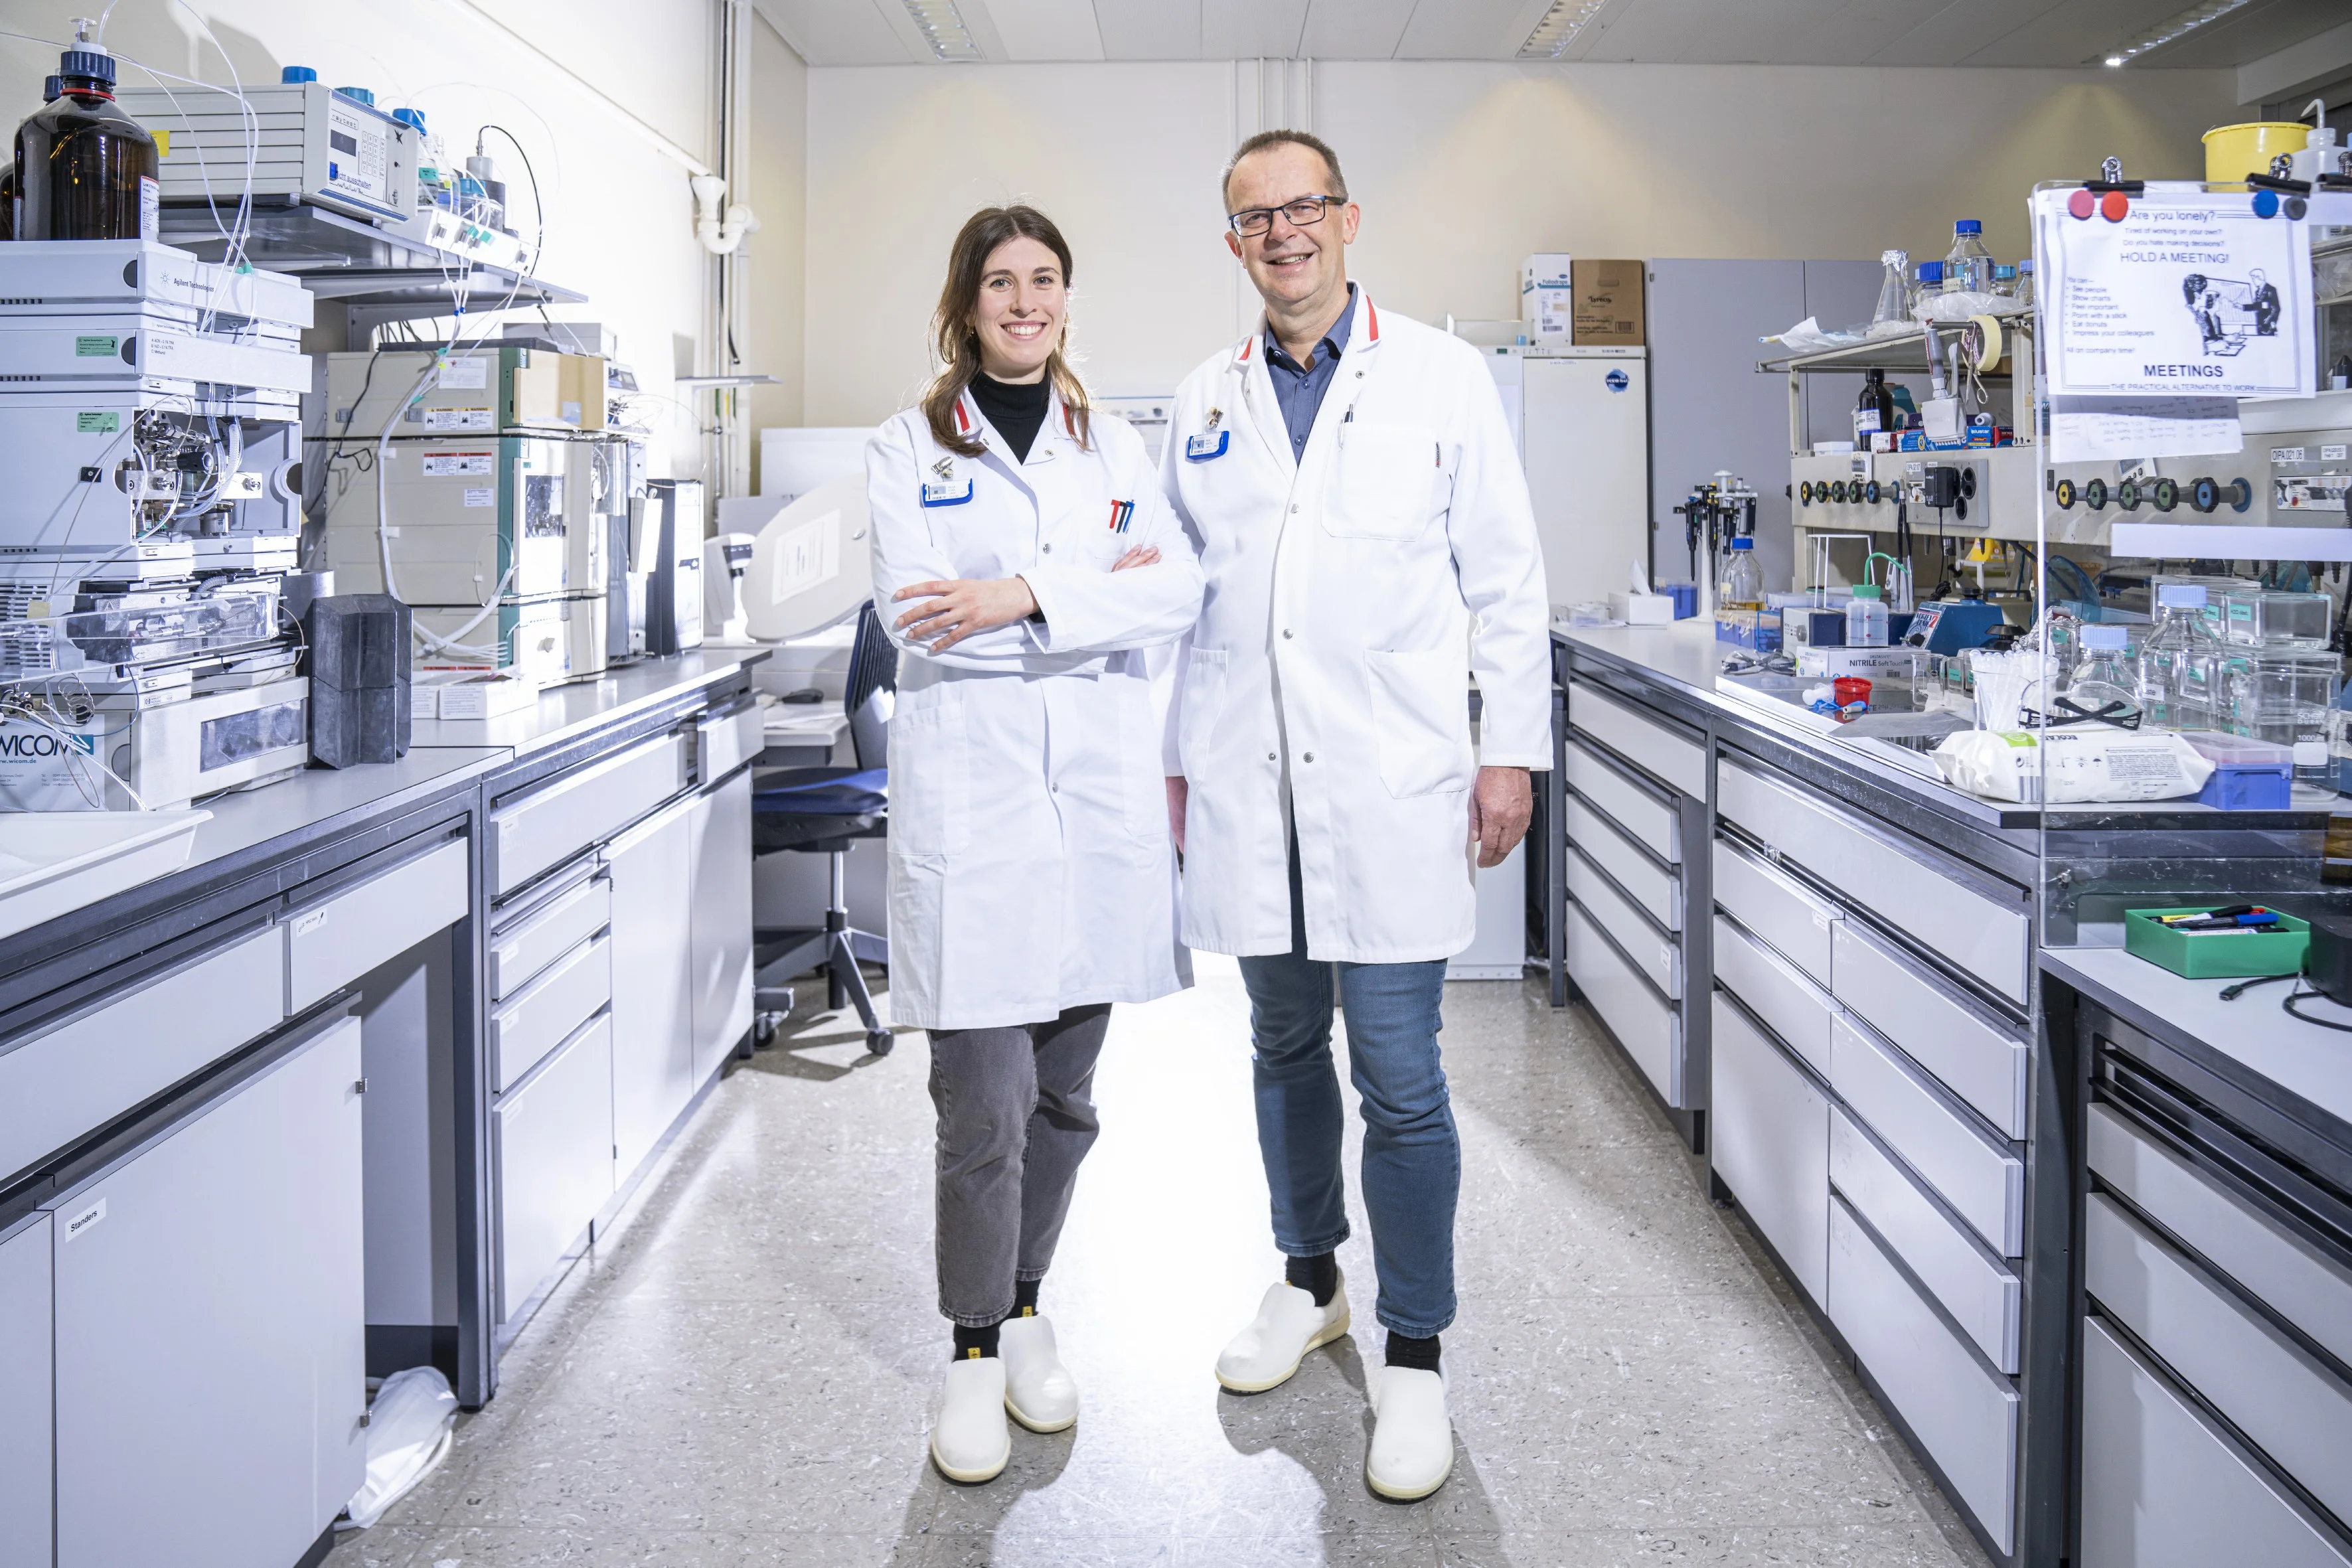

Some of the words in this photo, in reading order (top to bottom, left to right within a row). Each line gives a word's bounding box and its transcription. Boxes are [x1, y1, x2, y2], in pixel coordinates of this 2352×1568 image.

[332, 114, 356, 128] raytest
[2130, 211, 2148, 220] Are
[2154, 212, 2173, 222] you
[2177, 210, 2215, 223] lonely?
[2120, 252, 2157, 262] HOLD
[2159, 253, 2168, 262] A
[2171, 253, 2229, 263] MEETING!
[174, 278, 189, 287] Agilent
[189, 281, 214, 292] Technologies
[2144, 365, 2223, 377] MEETINGS
[2272, 449, 2303, 460] OIPA.021.06
[1928, 615, 1939, 628] 2
[71, 1210, 98, 1232] Standers
